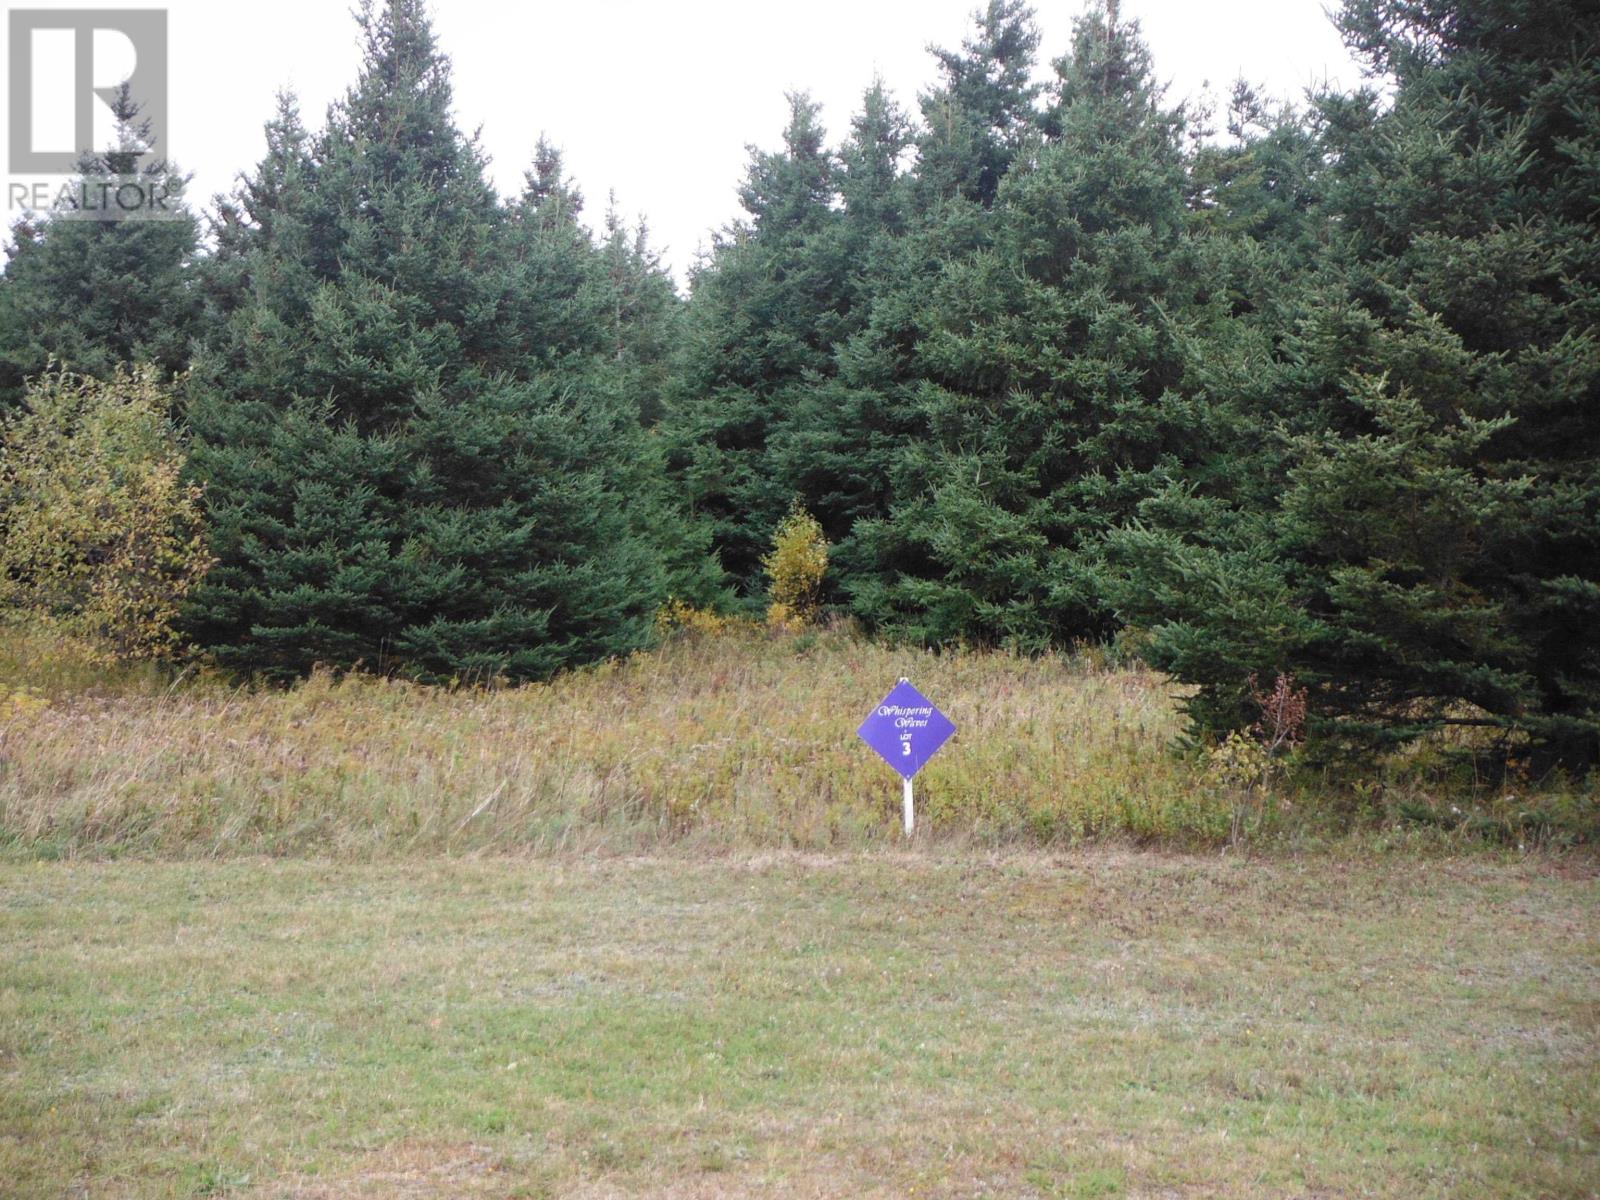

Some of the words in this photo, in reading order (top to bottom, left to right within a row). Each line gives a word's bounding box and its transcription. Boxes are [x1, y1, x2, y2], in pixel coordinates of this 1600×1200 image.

[878, 705, 933, 718] Whispering
[895, 717, 928, 728] Waves
[900, 733, 912, 741] LOT
[902, 742, 911, 756] 3
